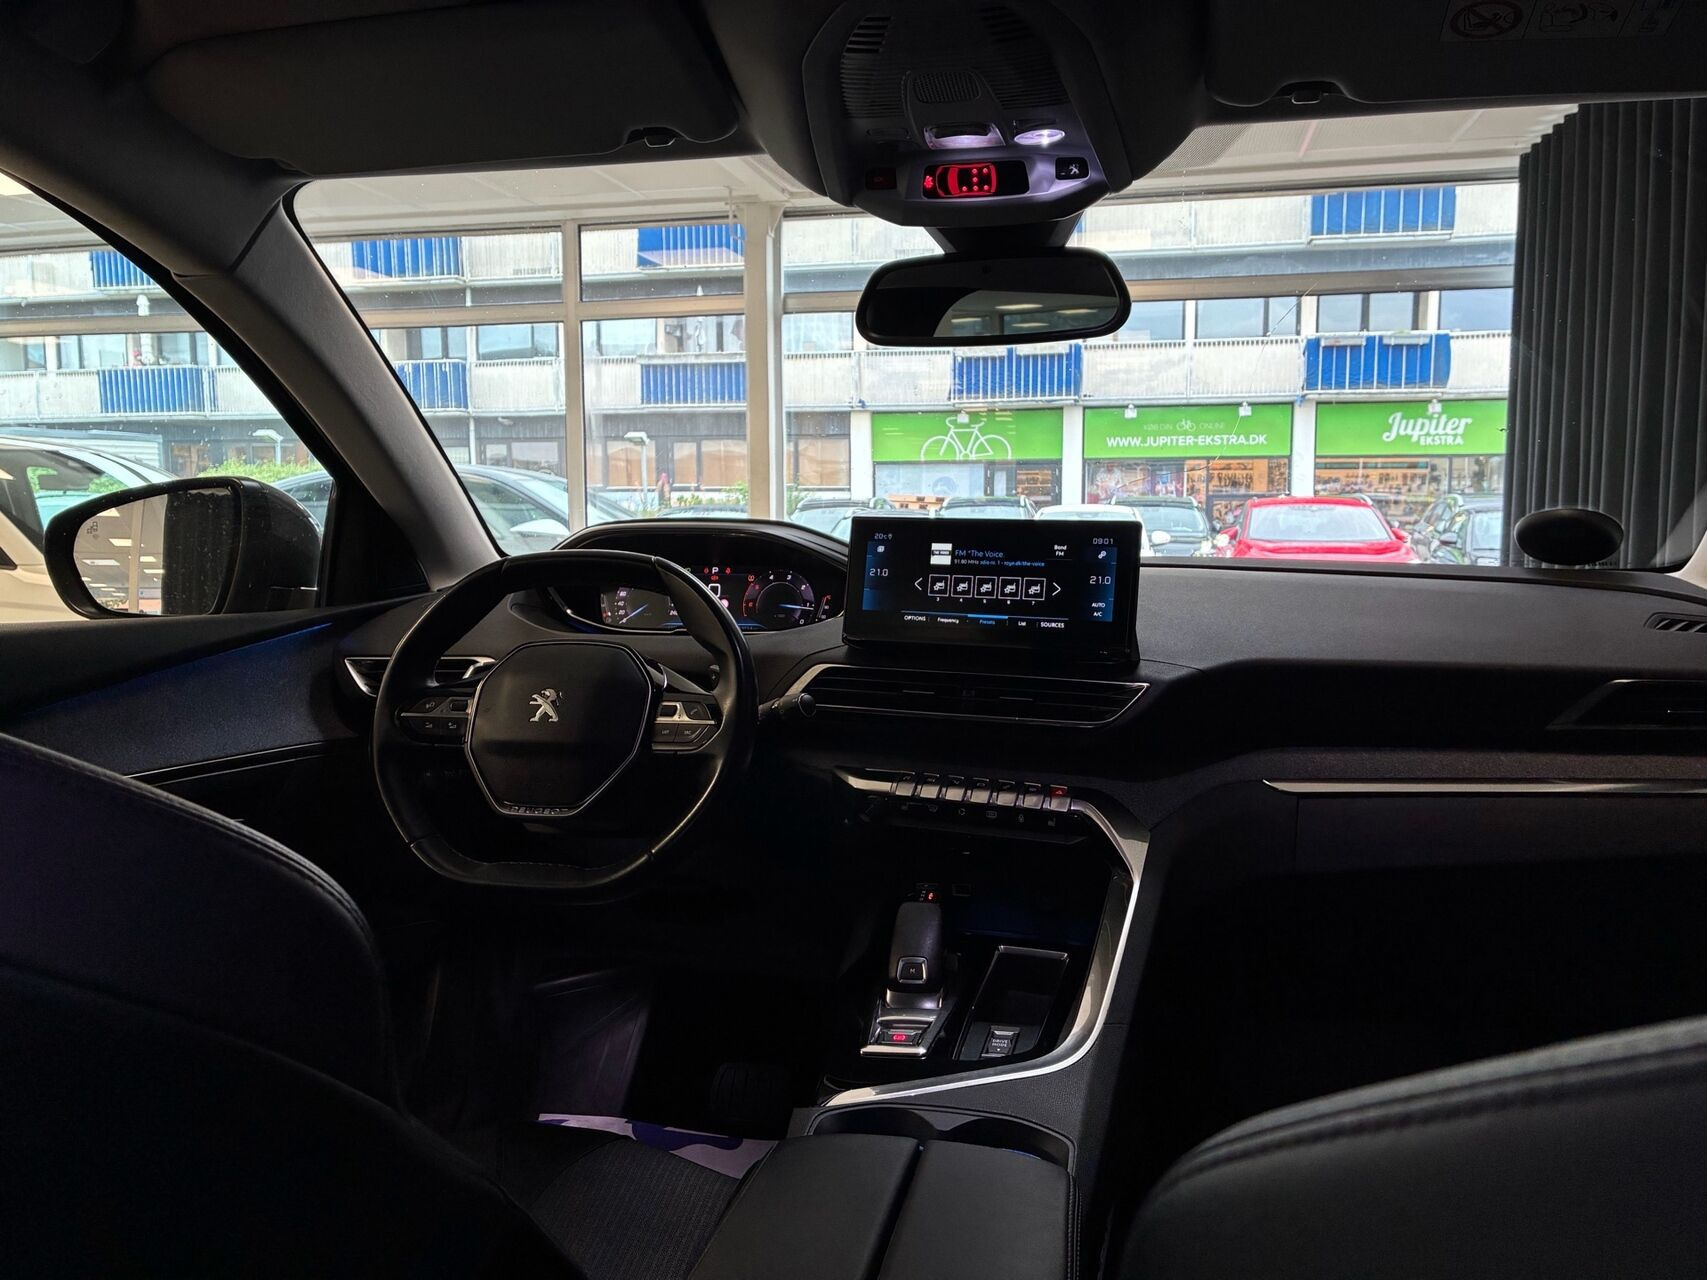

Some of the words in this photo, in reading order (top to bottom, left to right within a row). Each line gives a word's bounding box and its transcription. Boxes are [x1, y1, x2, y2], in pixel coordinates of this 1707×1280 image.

[1382, 412, 1472, 442] Jupiter
[1106, 434, 1267, 448] WWW.JUPITER-EKSTRA.DK
[1420, 435, 1464, 446] EKSTRA
[1040, 621, 1065, 629] SOURCES
